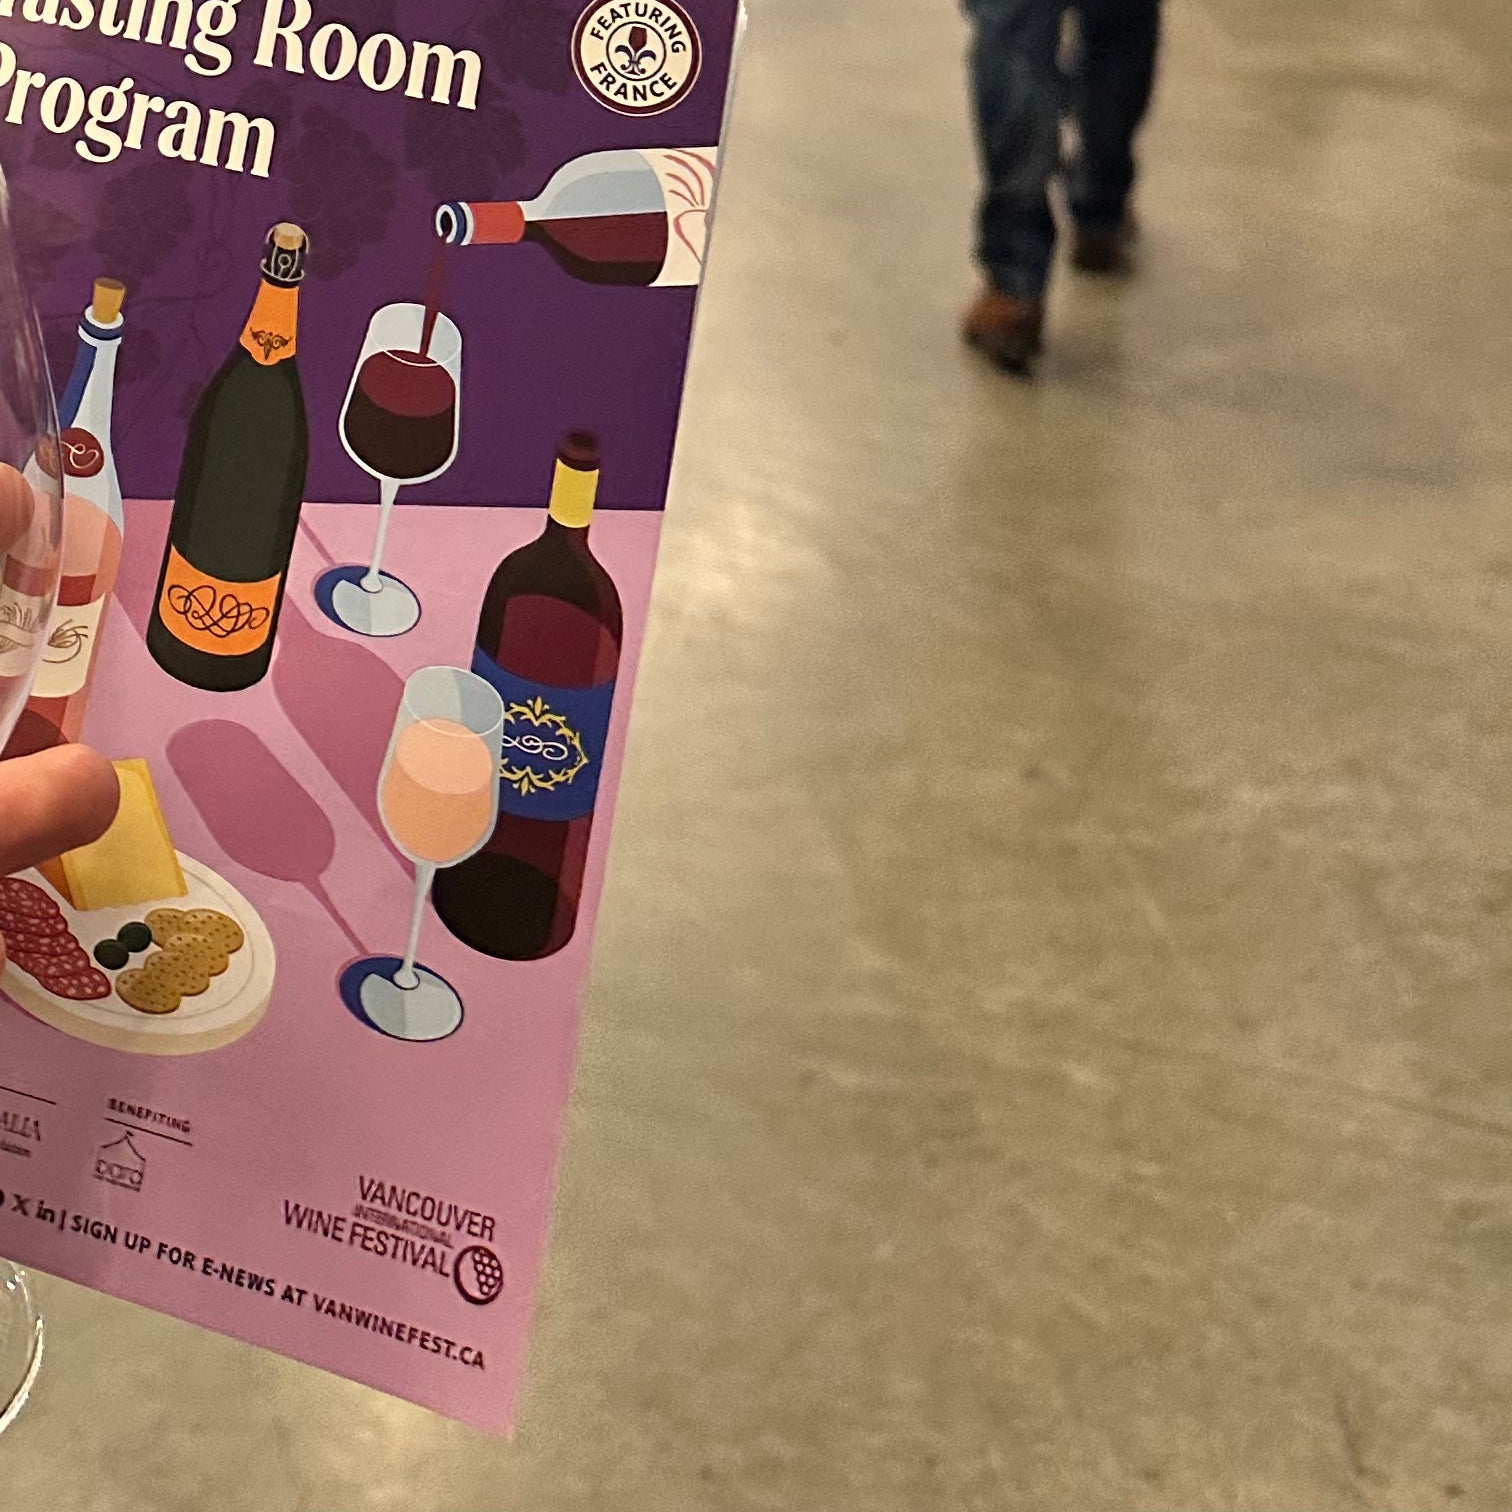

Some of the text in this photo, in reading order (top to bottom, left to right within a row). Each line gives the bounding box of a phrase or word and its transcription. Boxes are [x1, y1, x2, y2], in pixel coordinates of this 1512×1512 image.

[589, 2, 687, 53] FEATURING
[589, 61, 677, 101] FRANCE
[284, 1199, 450, 1278] WINE FESTIVAL
[359, 1175, 495, 1242] VANCOUVER
[71, 1214, 118, 1244] SIGN
[123, 1231, 152, 1254] UP
[157, 1242, 196, 1271] FOR
[202, 1256, 276, 1297] E-NEWS
[280, 1285, 308, 1307] AT
[313, 1293, 486, 1370] VANWINEFEST.CA
